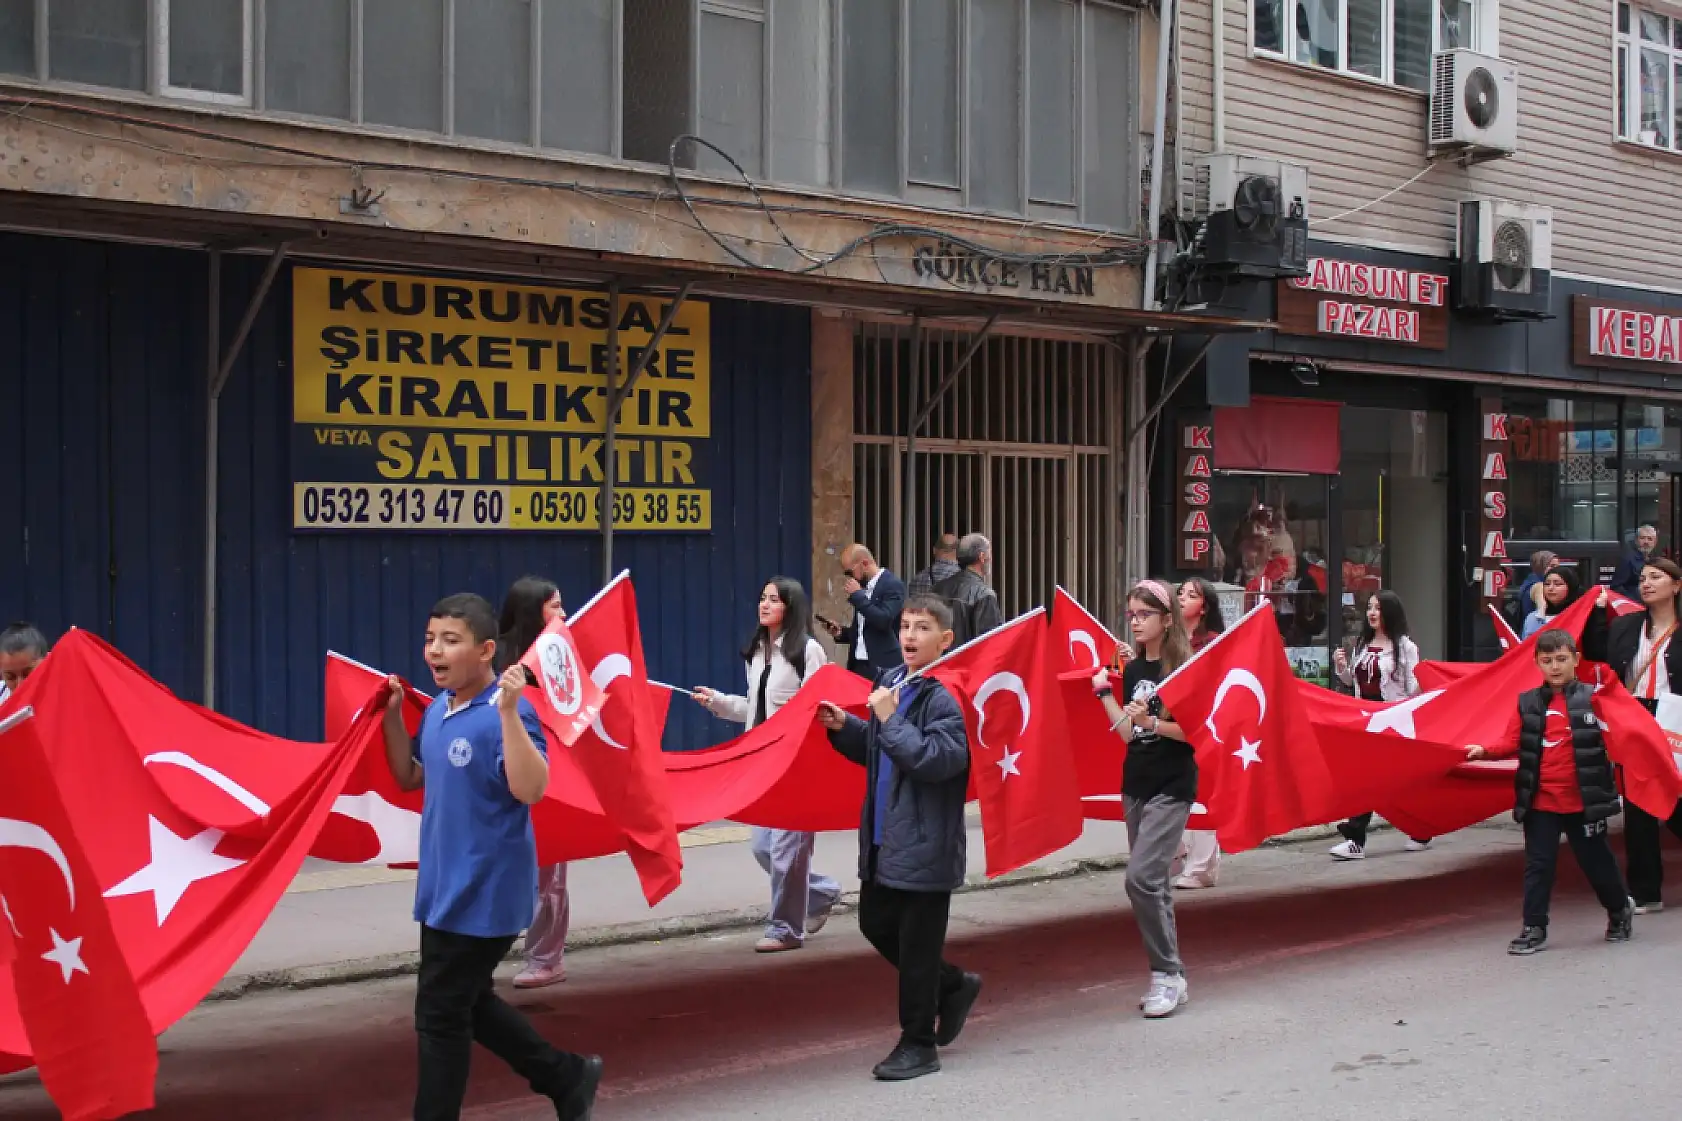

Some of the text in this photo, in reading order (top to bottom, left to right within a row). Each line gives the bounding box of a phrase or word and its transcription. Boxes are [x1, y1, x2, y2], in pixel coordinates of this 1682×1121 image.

[328, 277, 690, 336] KURUMSAL
[1030, 262, 1094, 296] HAN
[1415, 273, 1449, 306] ET
[1321, 301, 1421, 342] PAZARI
[1594, 307, 1682, 364] KEBA
[313, 429, 696, 485] VEYA SATILIKTIR
[303, 487, 370, 523] 0532
[379, 488, 426, 523] 313
[434, 489, 465, 523] 47
[473, 489, 503, 524] 60
[514, 507, 522, 516] -
[530, 492, 586, 524] 0530
[643, 493, 668, 523] 38
[676, 493, 701, 524] 55
[1187, 426, 1212, 562] KASAP
[1484, 413, 1508, 597] KASAP
